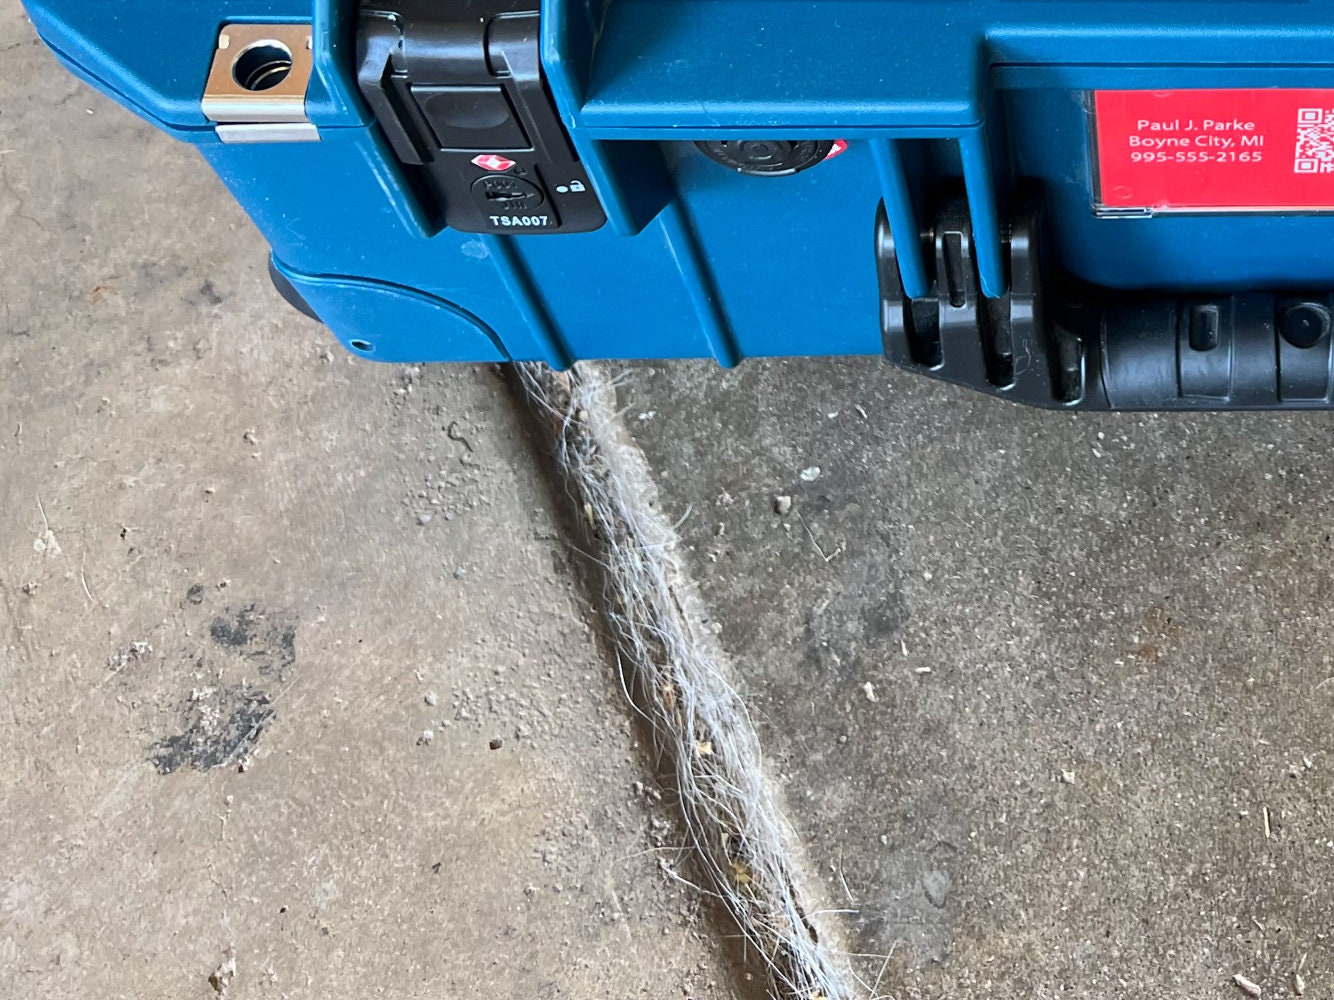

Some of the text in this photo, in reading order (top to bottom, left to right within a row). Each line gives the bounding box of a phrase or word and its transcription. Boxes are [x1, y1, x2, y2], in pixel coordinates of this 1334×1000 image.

[1137, 119, 1256, 131] Paul J. Parke
[1129, 134, 1264, 149] Boyne City, MI
[1131, 151, 1263, 163] 995-555-2165
[489, 215, 548, 227] TSA007
